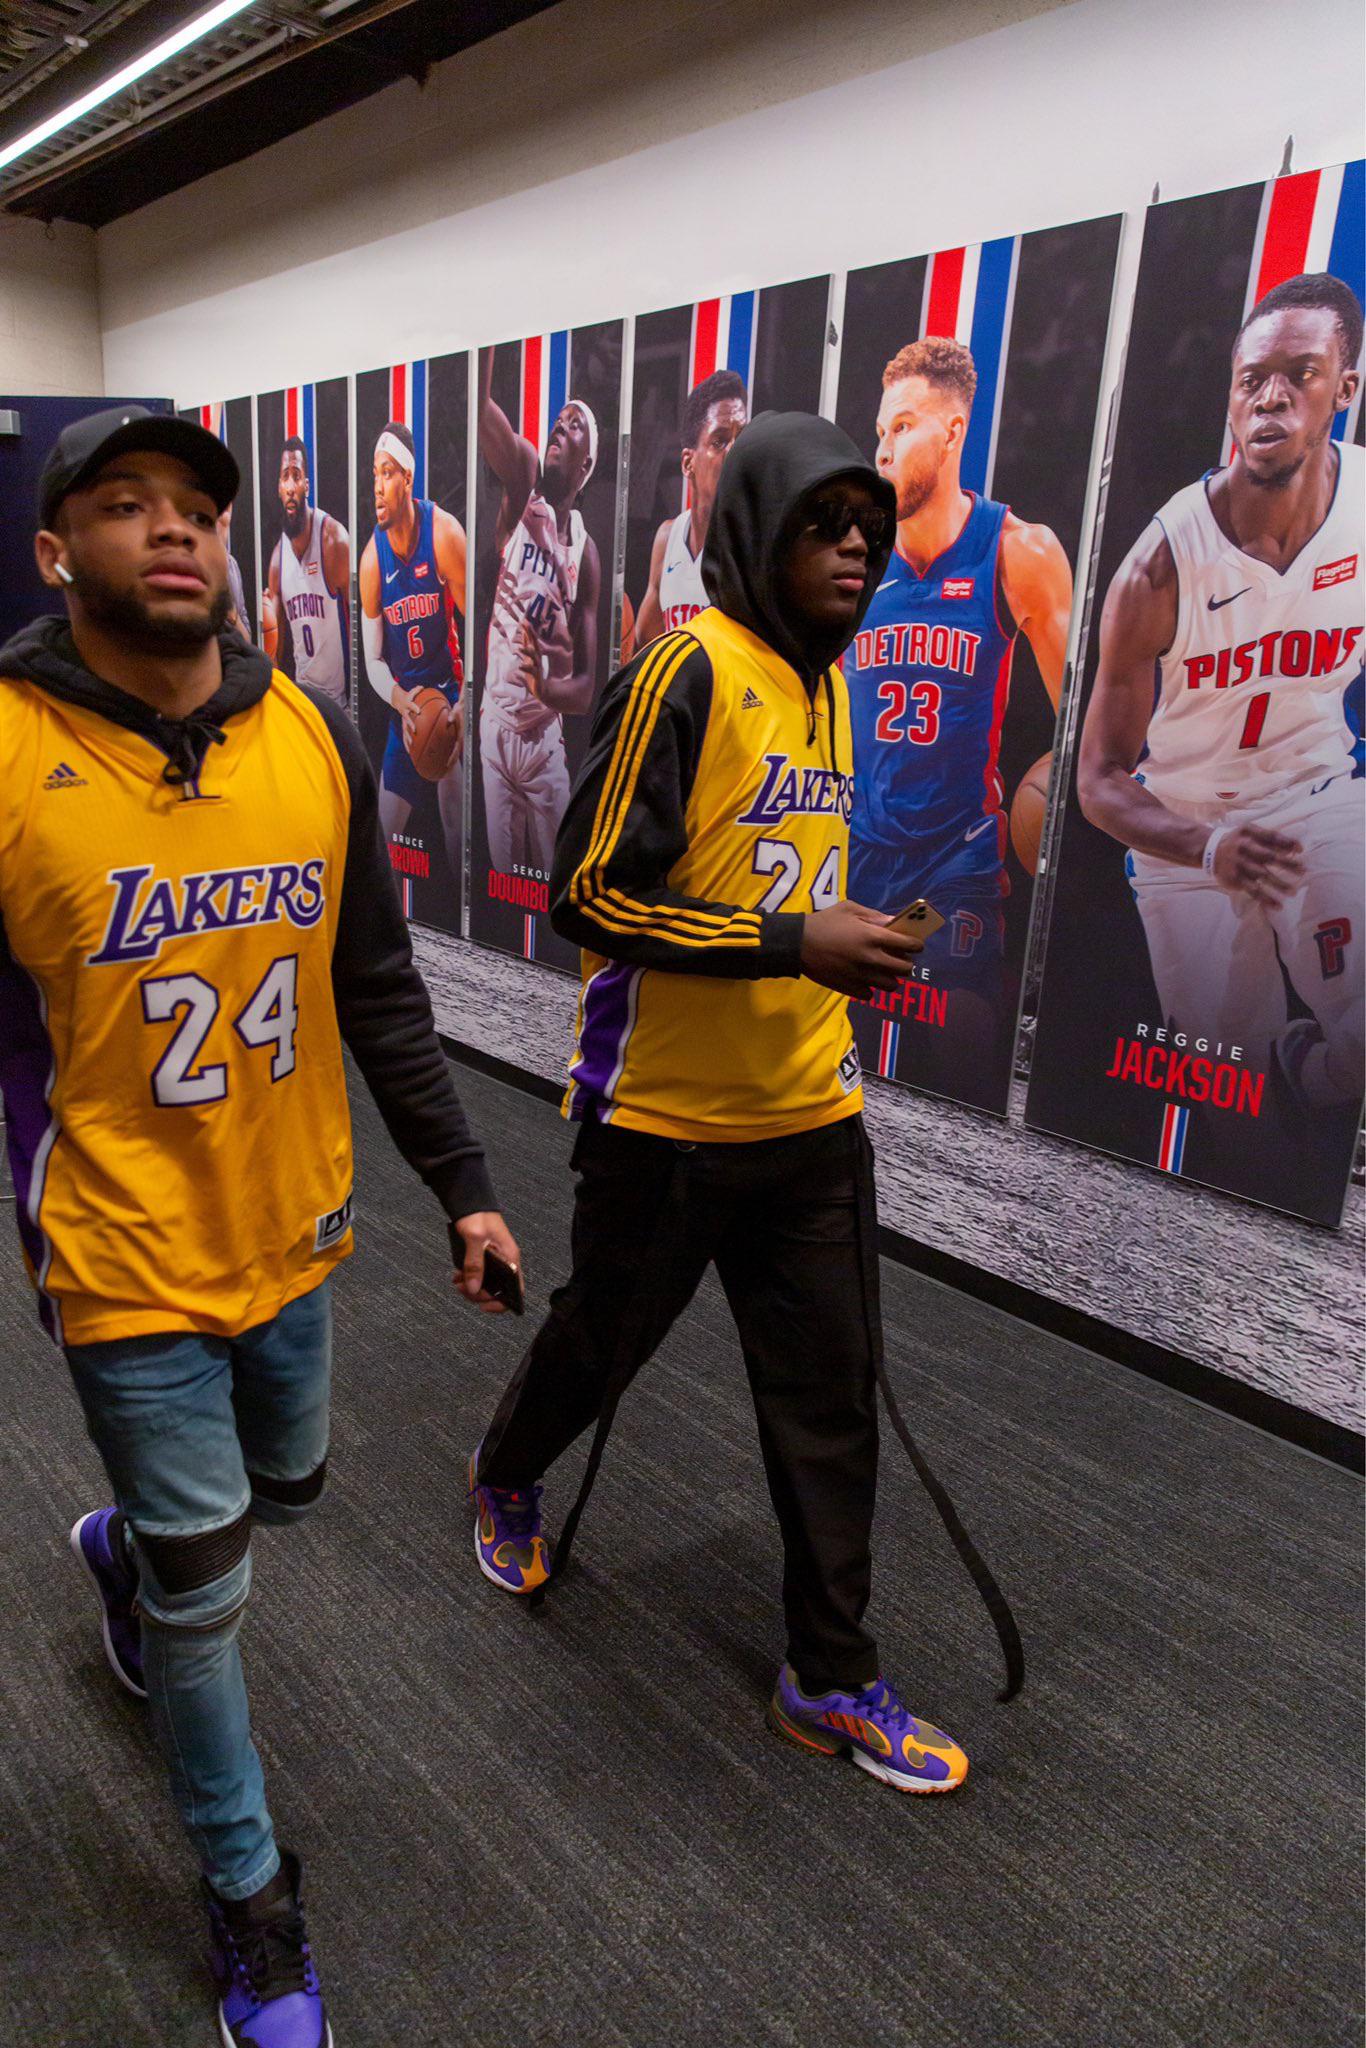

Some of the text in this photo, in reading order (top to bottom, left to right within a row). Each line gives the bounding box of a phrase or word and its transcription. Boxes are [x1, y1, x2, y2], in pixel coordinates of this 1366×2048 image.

[286, 593, 326, 622] DETROIT
[383, 592, 440, 627] DETROIT
[407, 625, 424, 660] 6
[854, 623, 982, 677] DETROIT
[1183, 626, 1365, 689] PISTONS
[875, 680, 942, 746] 23
[1239, 692, 1271, 750] 1
[735, 753, 855, 826] LAKERS
[392, 833, 424, 849] BRUCE
[513, 864, 551, 882] SEKOU
[751, 837, 840, 913] 24
[84, 858, 326, 967] LAKERS
[139, 952, 299, 1108] 24
[1136, 1023, 1244, 1061] REGGIE
[1106, 1037, 1265, 1118] JACKSON
